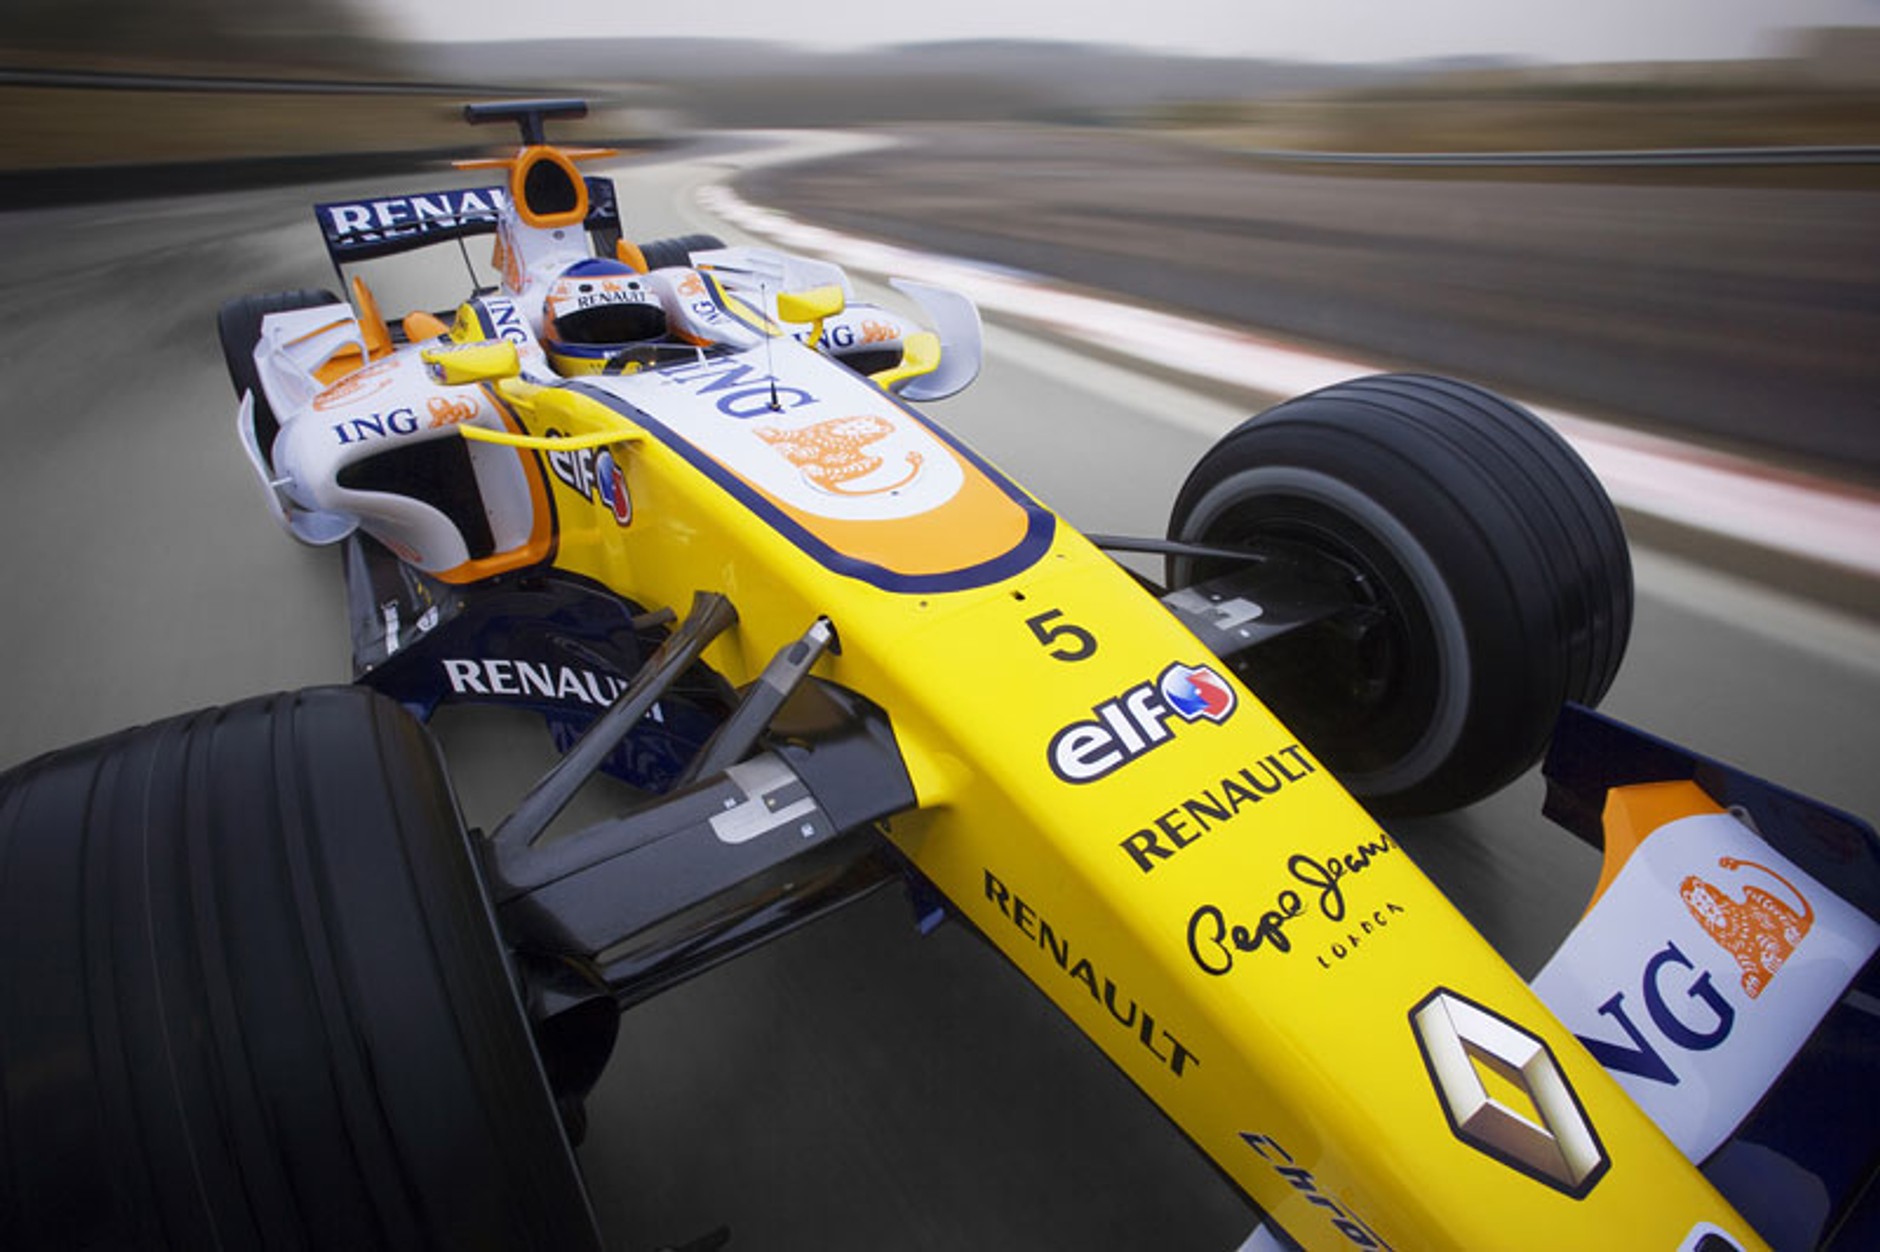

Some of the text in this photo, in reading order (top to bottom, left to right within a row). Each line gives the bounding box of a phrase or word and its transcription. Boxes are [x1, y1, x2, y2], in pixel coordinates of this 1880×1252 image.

[328, 189, 508, 243] RENA
[333, 408, 418, 445] ING
[658, 355, 821, 419] ING
[1025, 608, 1098, 662] 5
[1047, 680, 1176, 785] elf
[1120, 744, 1317, 874] RENAULT
[1187, 833, 1398, 976] Pepe Jean
[983, 867, 1200, 1078] RENAULT
[1573, 940, 1735, 1086] NG
[1238, 1130, 1380, 1252] Chro
